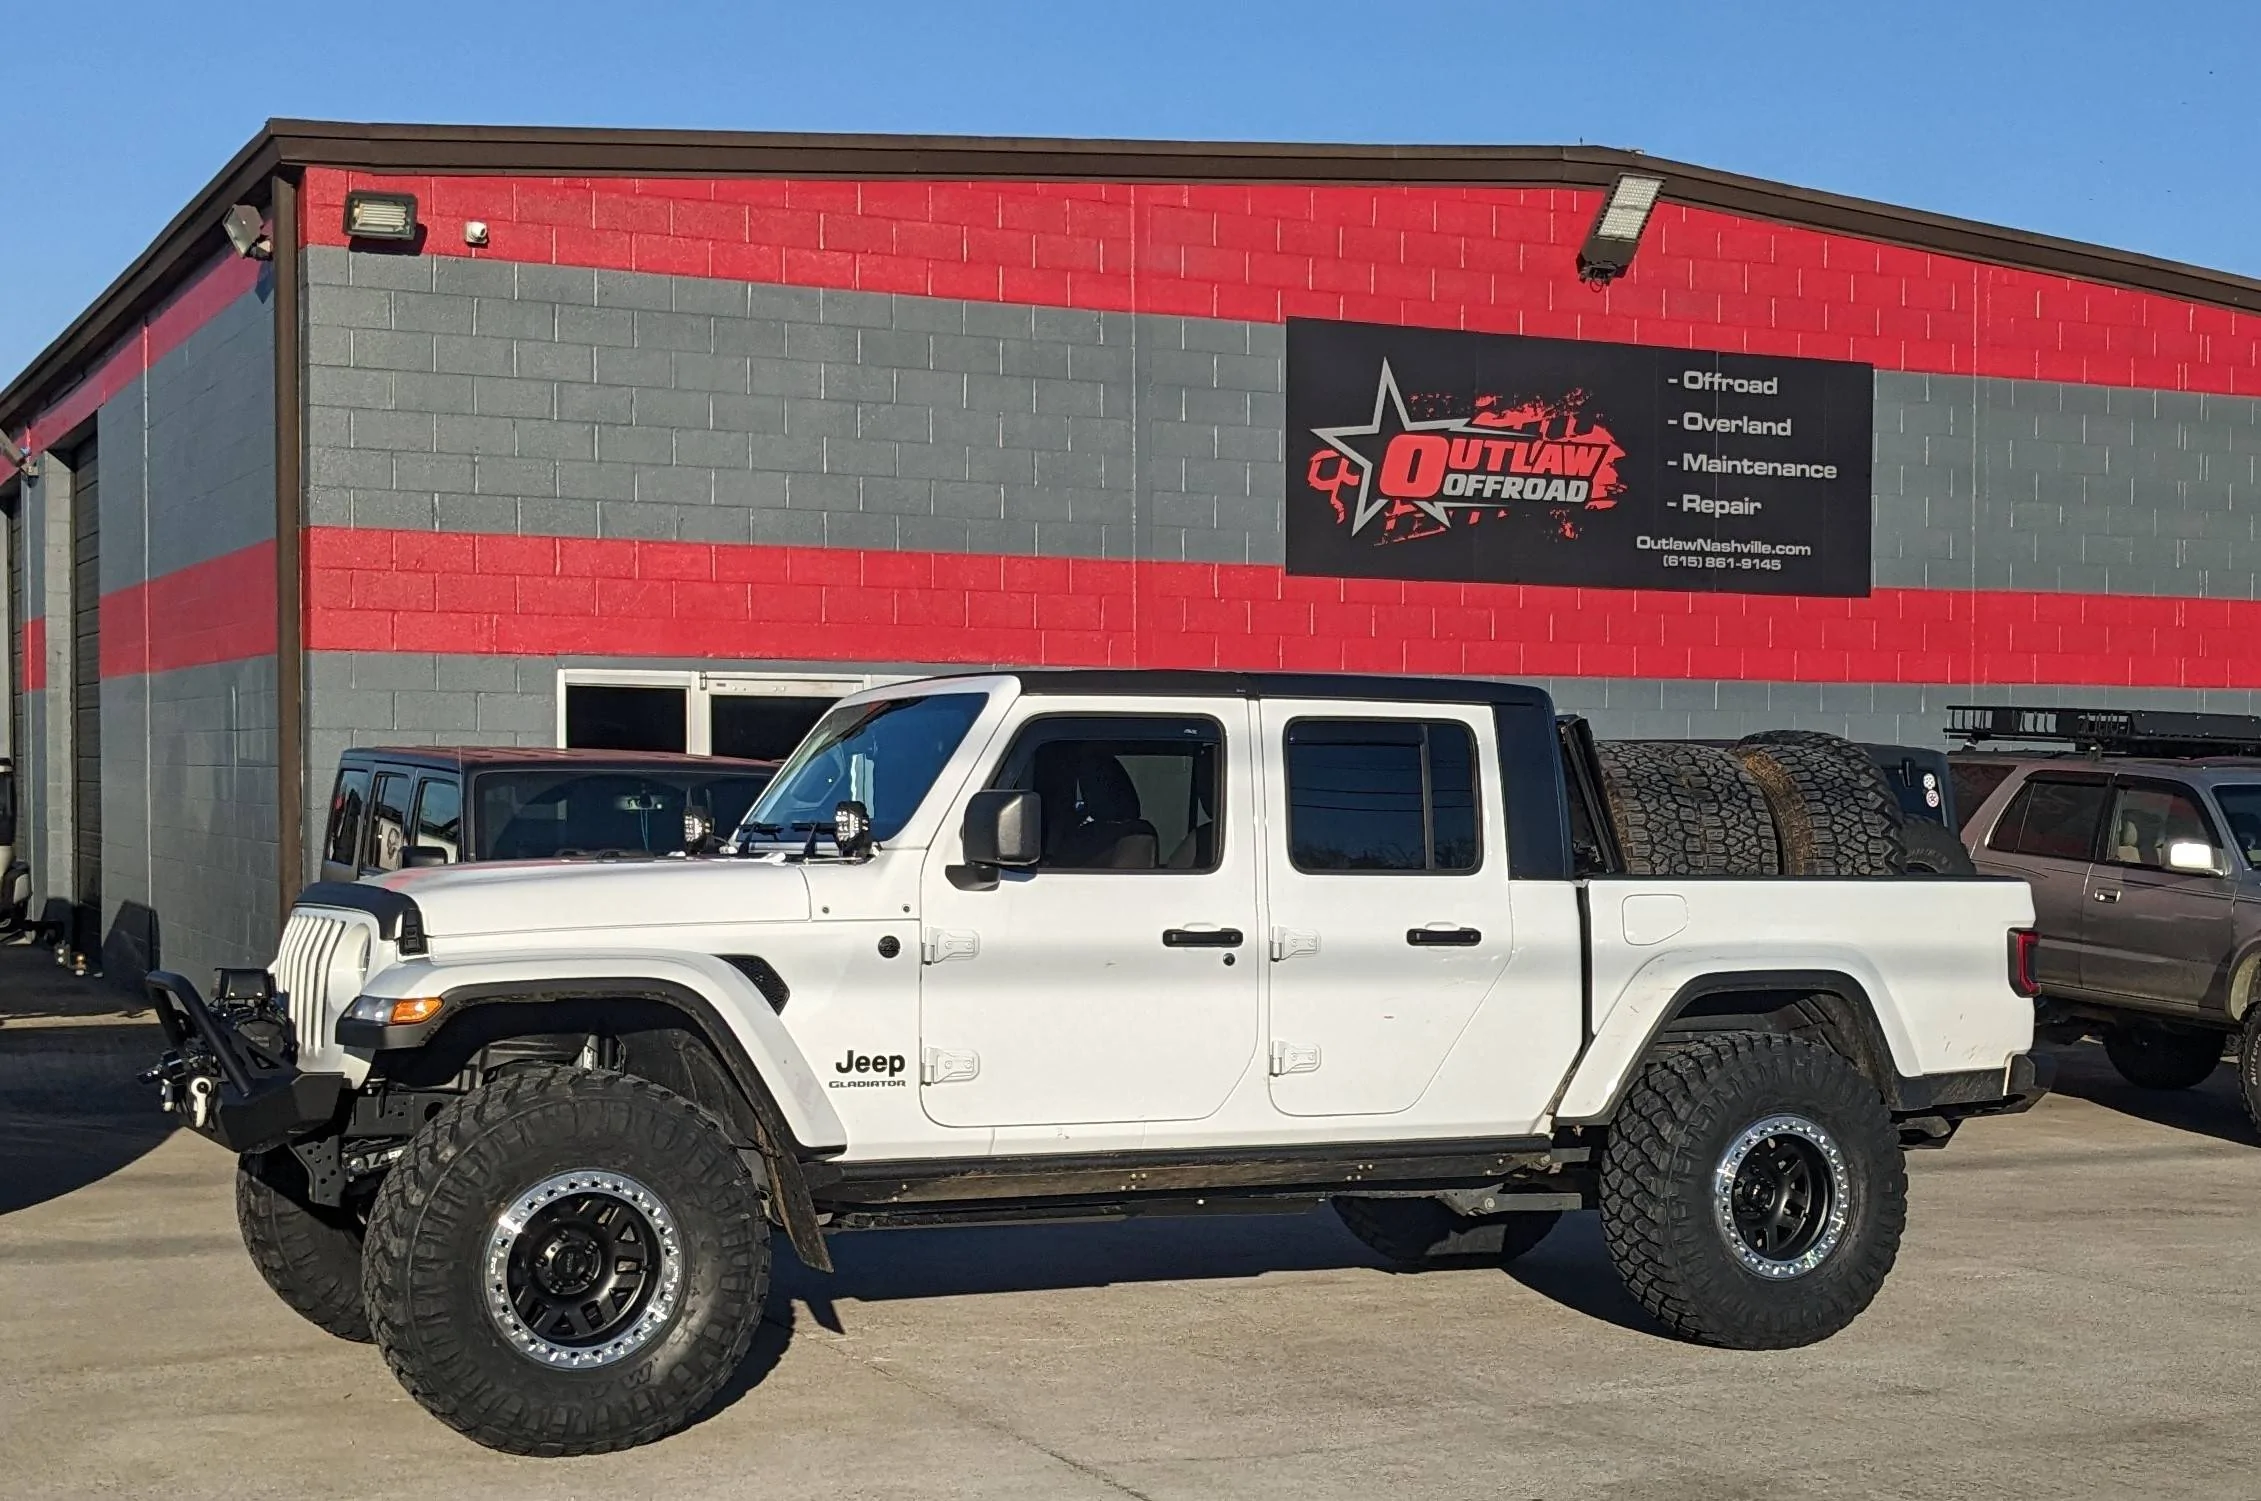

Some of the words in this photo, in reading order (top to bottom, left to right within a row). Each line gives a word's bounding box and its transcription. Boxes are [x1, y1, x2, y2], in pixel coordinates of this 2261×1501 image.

[1683, 370, 1778, 395] Offroad
[1683, 411, 1792, 436] Overland
[1379, 434, 1603, 499] OUTLAW
[1683, 452, 1838, 479] Maintenance
[1442, 473, 1589, 503] OFFROAD
[1682, 493, 1762, 519] Repair
[1636, 535, 1812, 556] OutlawNashville.com
[1663, 554, 1702, 568] (615)
[1705, 556, 1782, 571] 861-9145
[835, 1049, 906, 1077] Jeep
[828, 1080, 906, 1088] GLADIATOR
